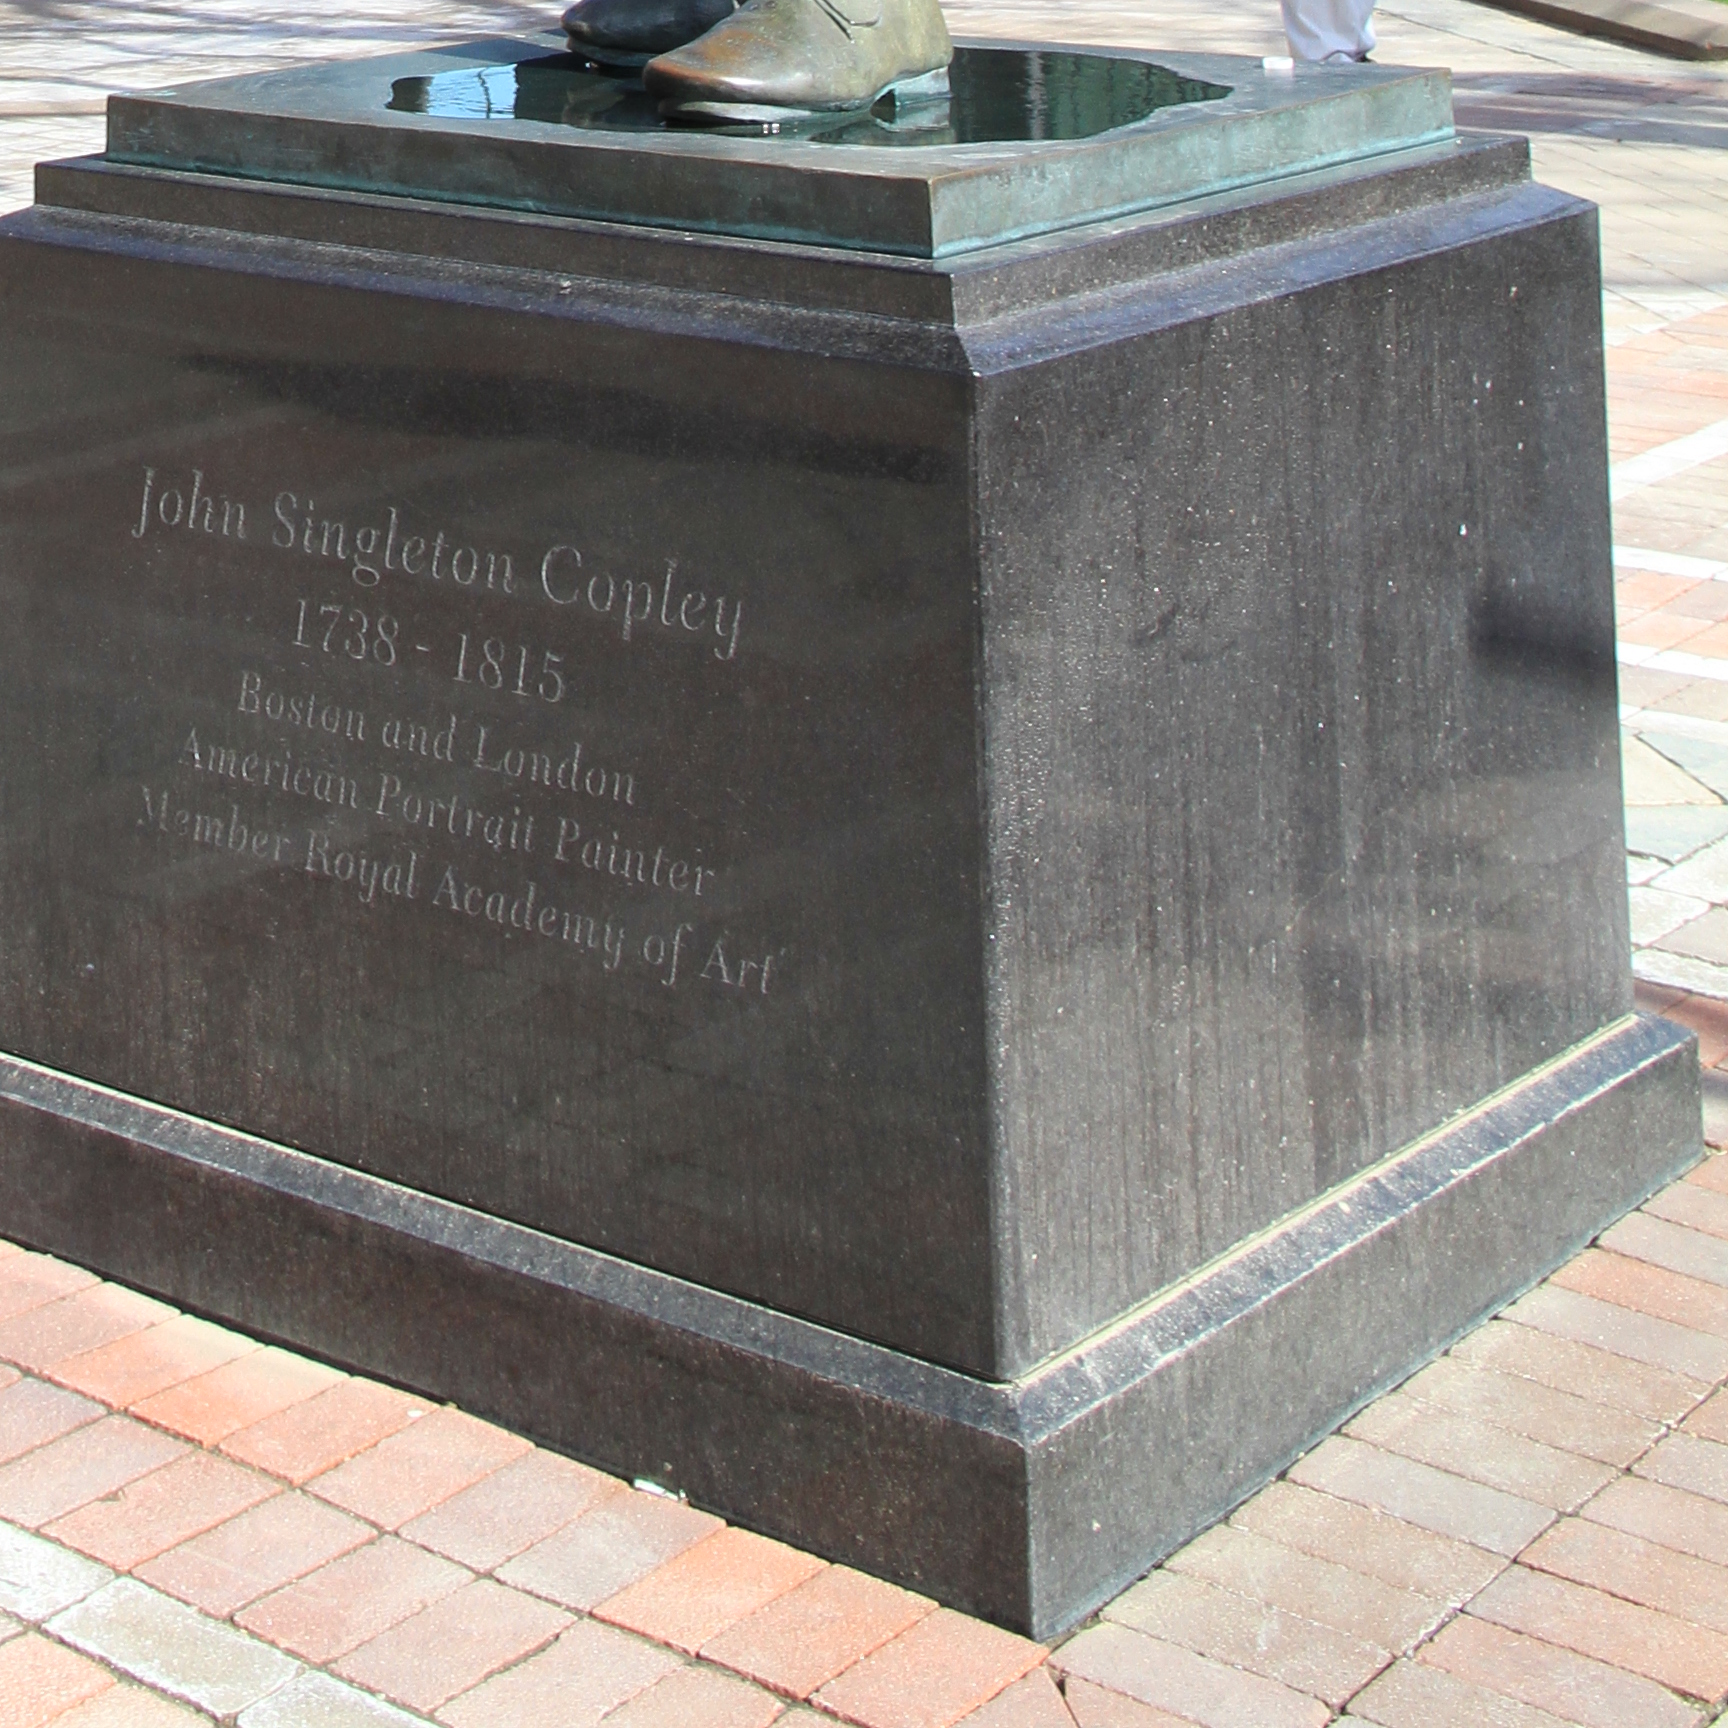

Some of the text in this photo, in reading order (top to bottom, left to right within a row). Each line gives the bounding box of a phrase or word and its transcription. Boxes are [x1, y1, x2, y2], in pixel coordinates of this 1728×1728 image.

[131, 466, 742, 661] John Singleton Copley
[292, 599, 399, 666] 1738
[453, 632, 565, 703] 1815
[178, 726, 716, 897] American Portrait Painter
[238, 670, 634, 806] Boston and London
[136, 785, 774, 995] Member Royal Academy of Art
